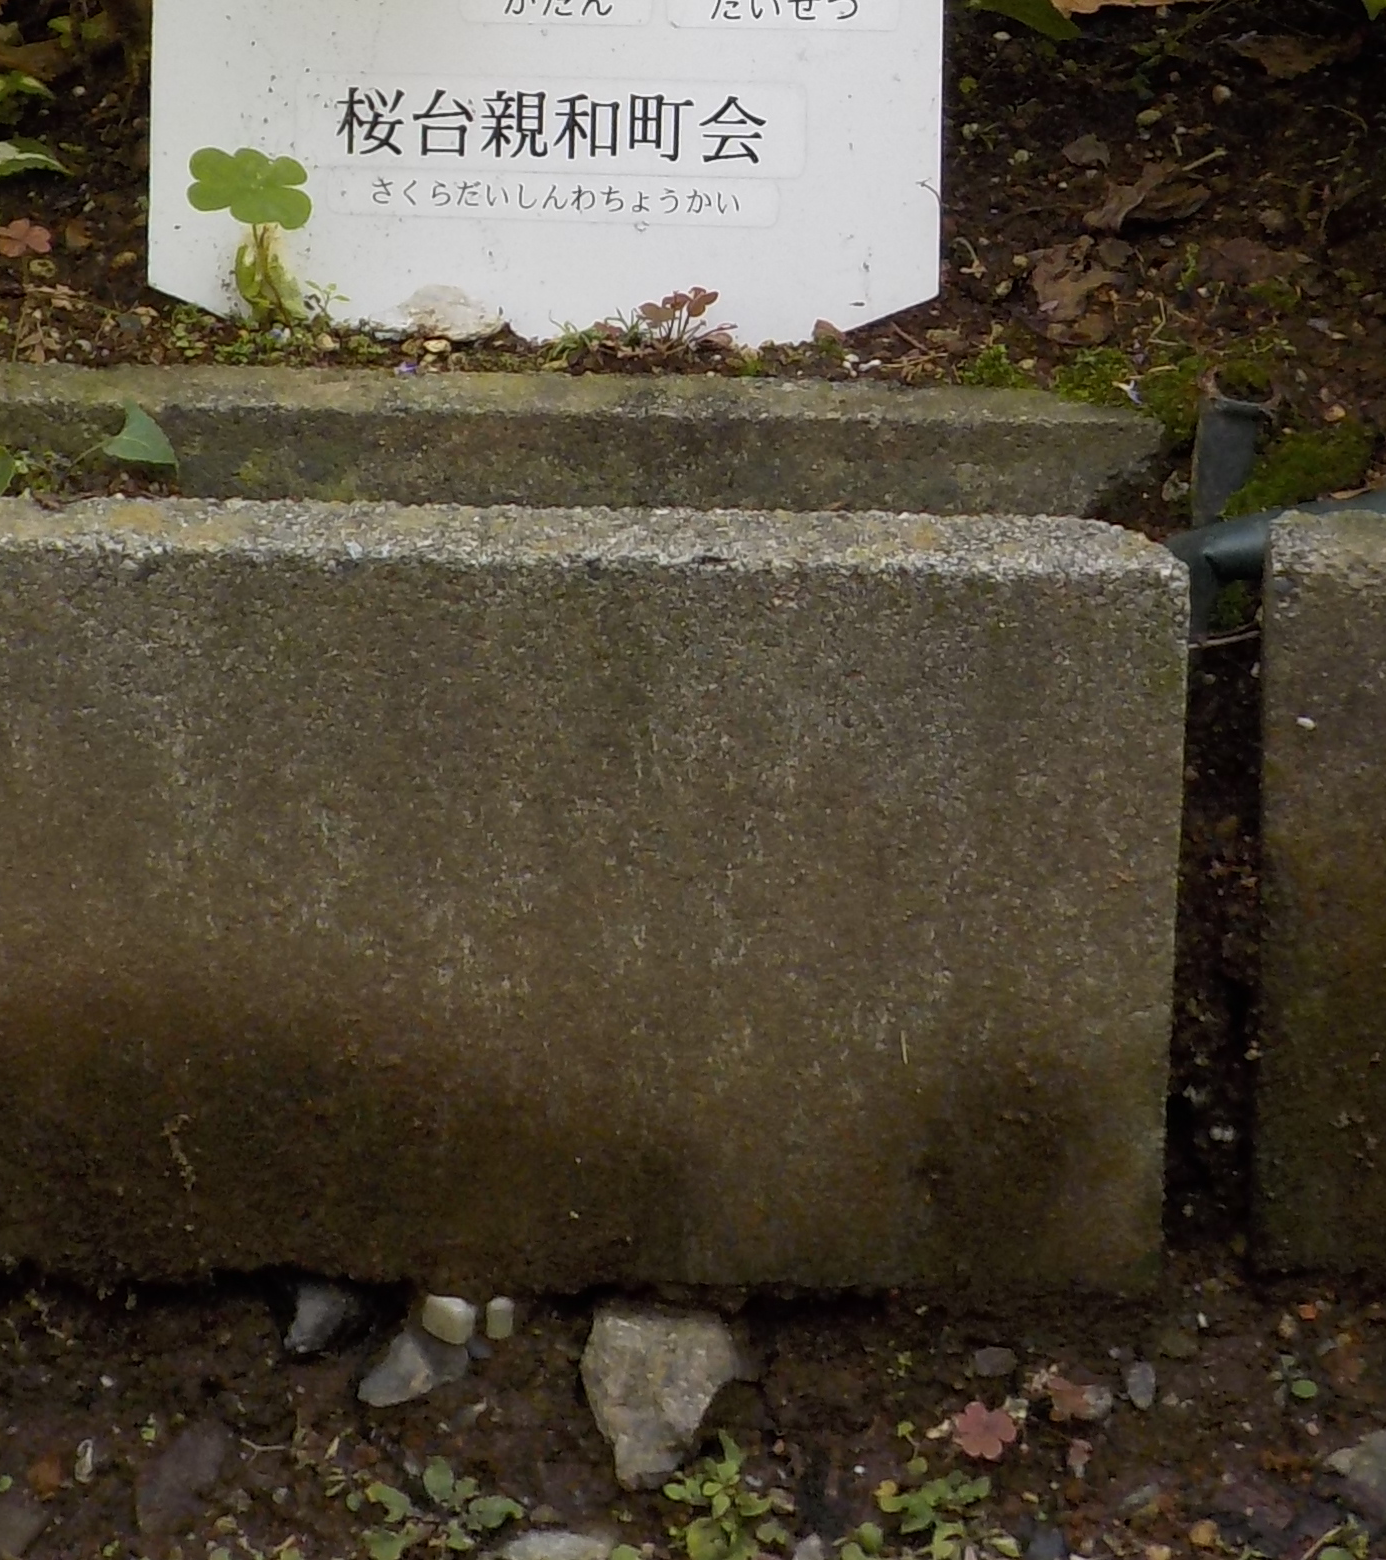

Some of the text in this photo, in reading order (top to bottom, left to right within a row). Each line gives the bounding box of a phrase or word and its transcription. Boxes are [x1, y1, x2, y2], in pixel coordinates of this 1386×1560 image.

[336, 86, 767, 165] 桜台親和町会
[370, 176, 740, 215] さくらだいしんわちょうかい
